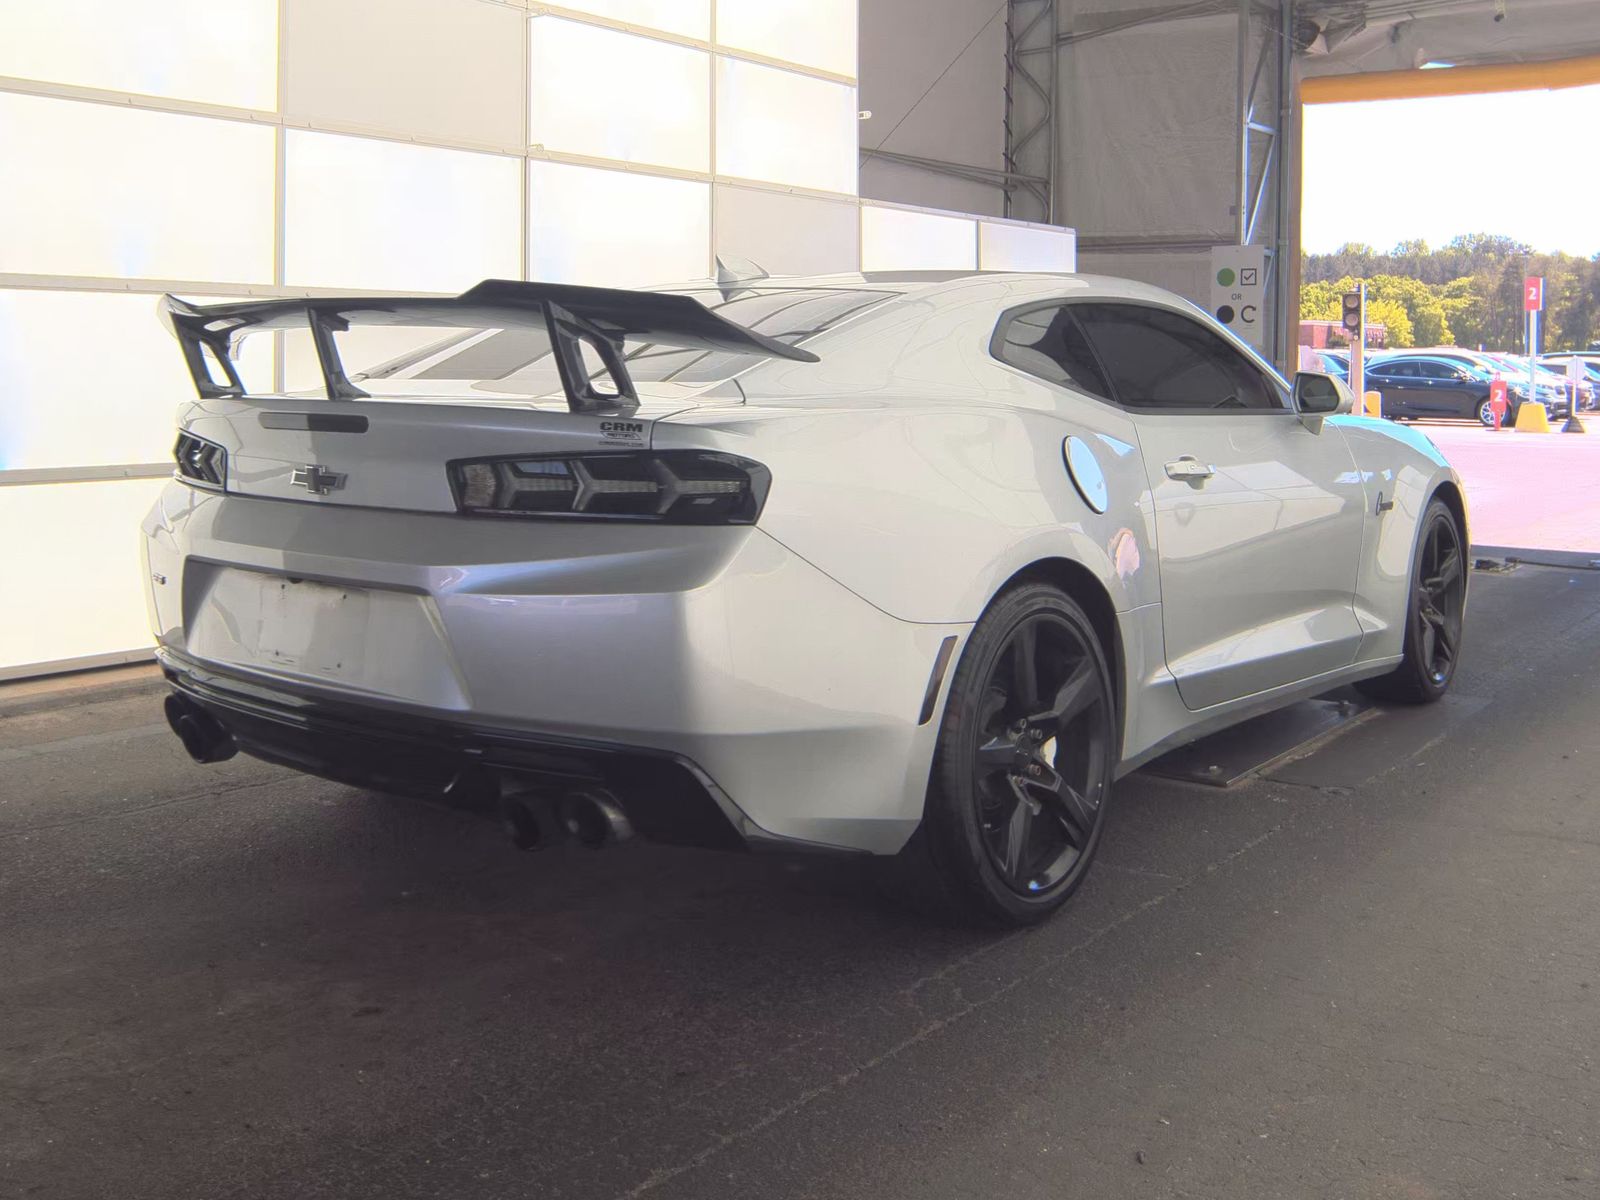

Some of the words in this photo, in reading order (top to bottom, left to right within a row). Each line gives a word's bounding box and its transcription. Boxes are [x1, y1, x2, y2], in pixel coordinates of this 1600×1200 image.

[1231, 293, 1242, 301] OR
[1528, 287, 1537, 300] 2
[1494, 389, 1503, 402] 2
[600, 421, 643, 432] CRM
